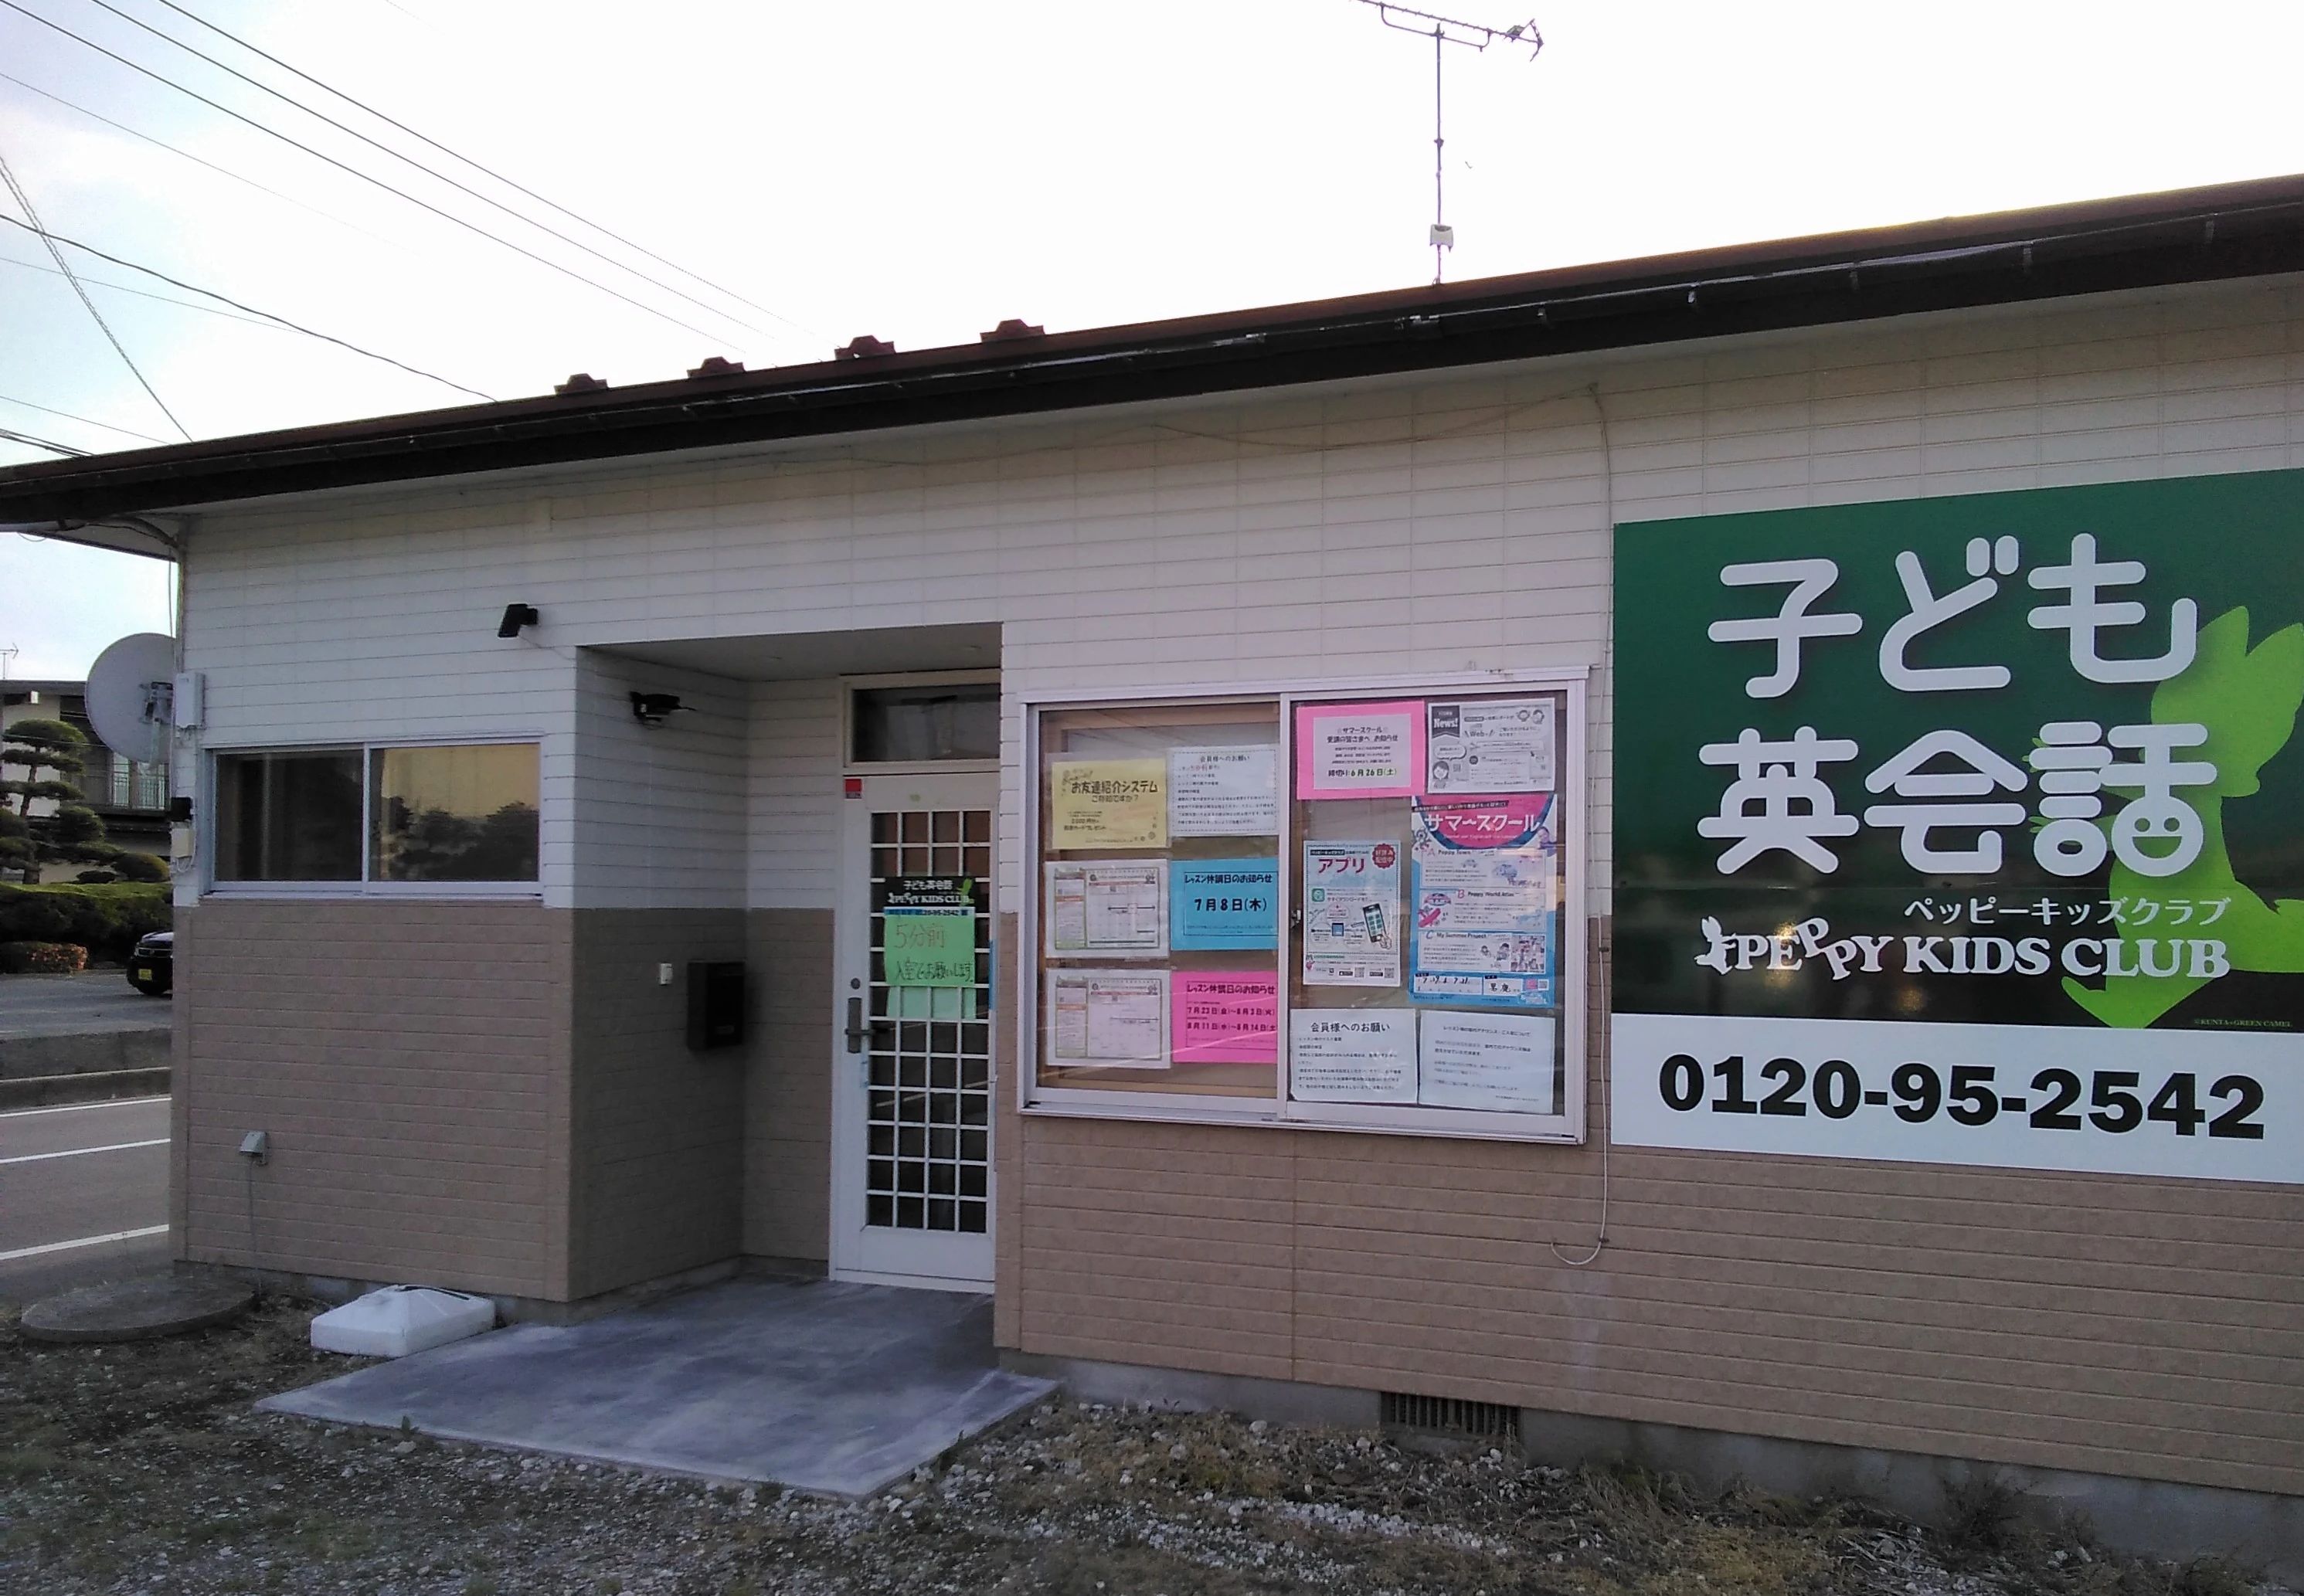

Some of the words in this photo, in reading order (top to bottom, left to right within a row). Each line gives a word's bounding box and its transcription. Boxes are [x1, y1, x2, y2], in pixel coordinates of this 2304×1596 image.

[1708, 533, 2197, 698] 子ども
[1071, 780, 1158, 794] お友達紹介システム
[1697, 722, 2217, 877] 英会話
[1424, 813, 1541, 832] サマースクール
[1318, 857, 1365, 873] アプリ
[1194, 898, 1267, 912] 7月8日(木)
[1904, 896, 2231, 927] ペッピーキッズクラブ
[1735, 918, 1894, 980] PEPPY
[1903, 936, 2050, 976] KIDS
[2061, 937, 2230, 979] CLUB
[1311, 1022, 1391, 1033] 会員様へのお願い
[1659, 1054, 2264, 1140] 0120-95-2542
